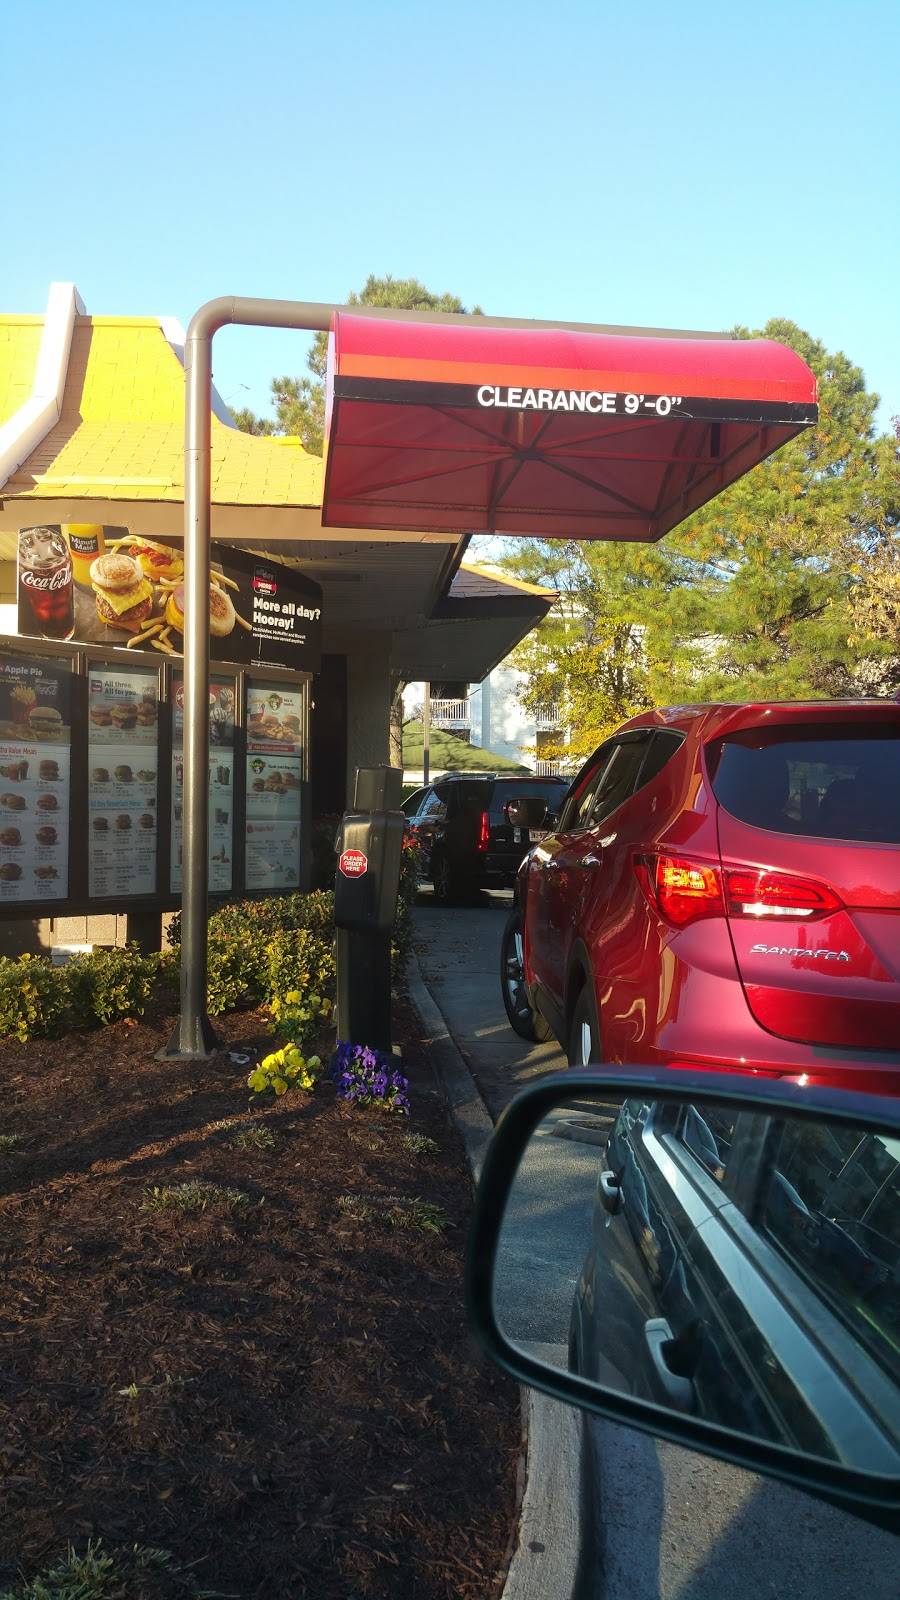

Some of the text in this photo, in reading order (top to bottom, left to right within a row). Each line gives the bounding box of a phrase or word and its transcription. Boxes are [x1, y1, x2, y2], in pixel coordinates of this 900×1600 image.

[477, 385, 616, 413] CLEARANCE
[253, 596, 320, 621] More all day?
[253, 611, 294, 631] Hooray!
[4, 665, 43, 676] Apple Pie
